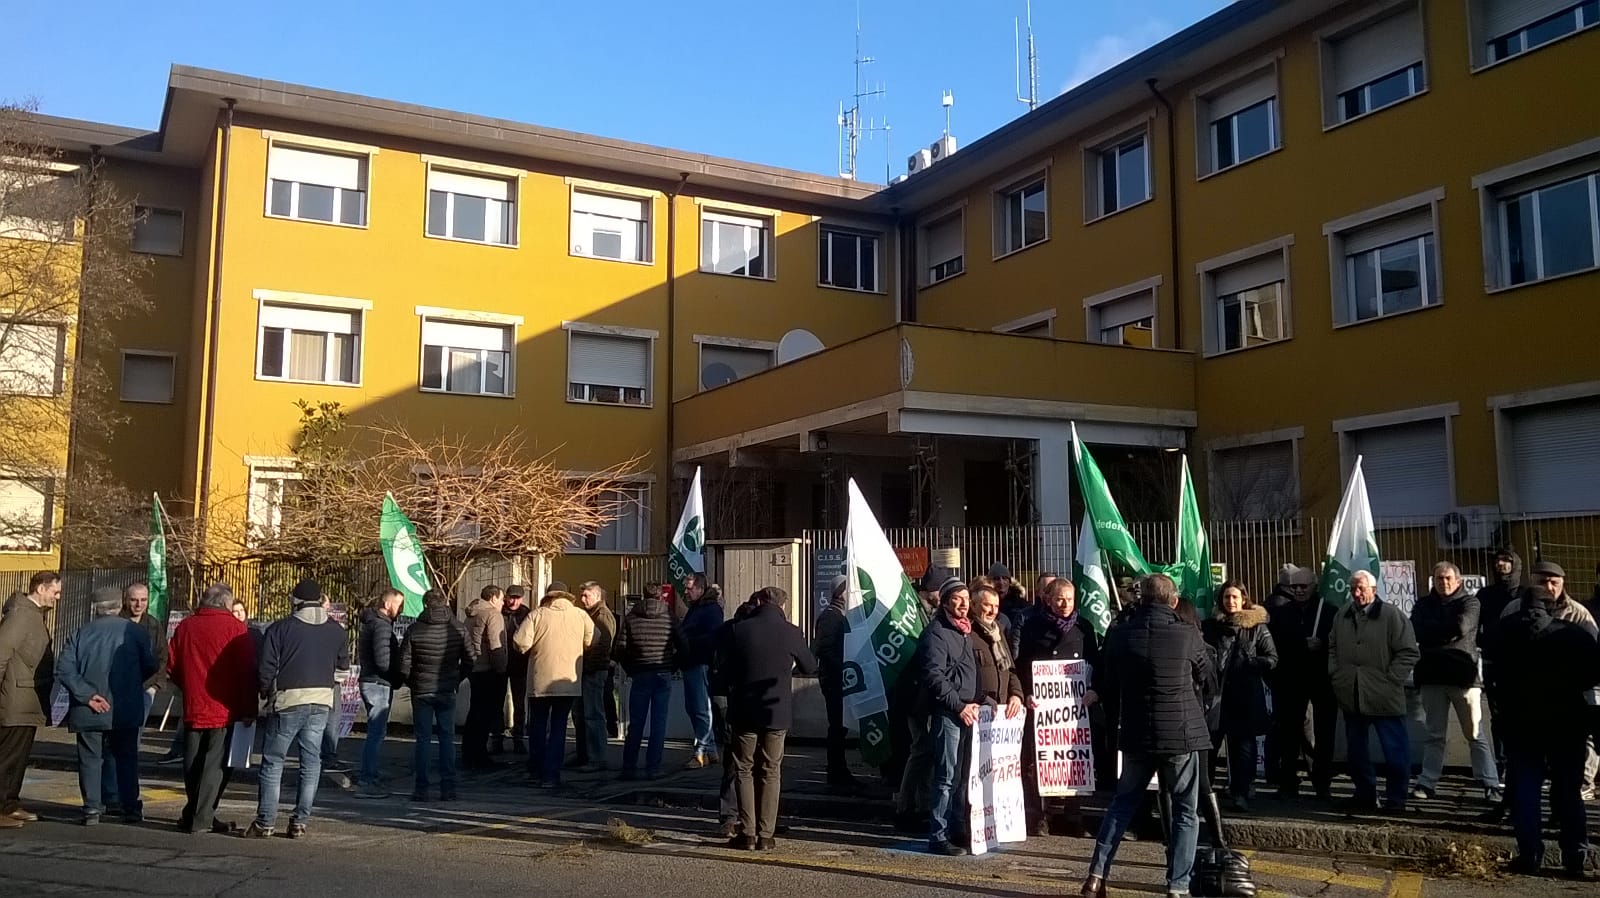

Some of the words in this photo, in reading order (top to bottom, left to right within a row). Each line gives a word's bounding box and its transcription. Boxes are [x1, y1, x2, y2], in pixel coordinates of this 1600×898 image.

[781, 555, 786, 563] 2
[1034, 681, 1085, 700] DOBBIAMO
[1036, 704, 1087, 728] ANCORA
[1037, 727, 1090, 747] SEMINARE
[1038, 750, 1048, 761] E
[1053, 750, 1090, 761] NON
[1039, 761, 1086, 787] RACCOGLIERE
